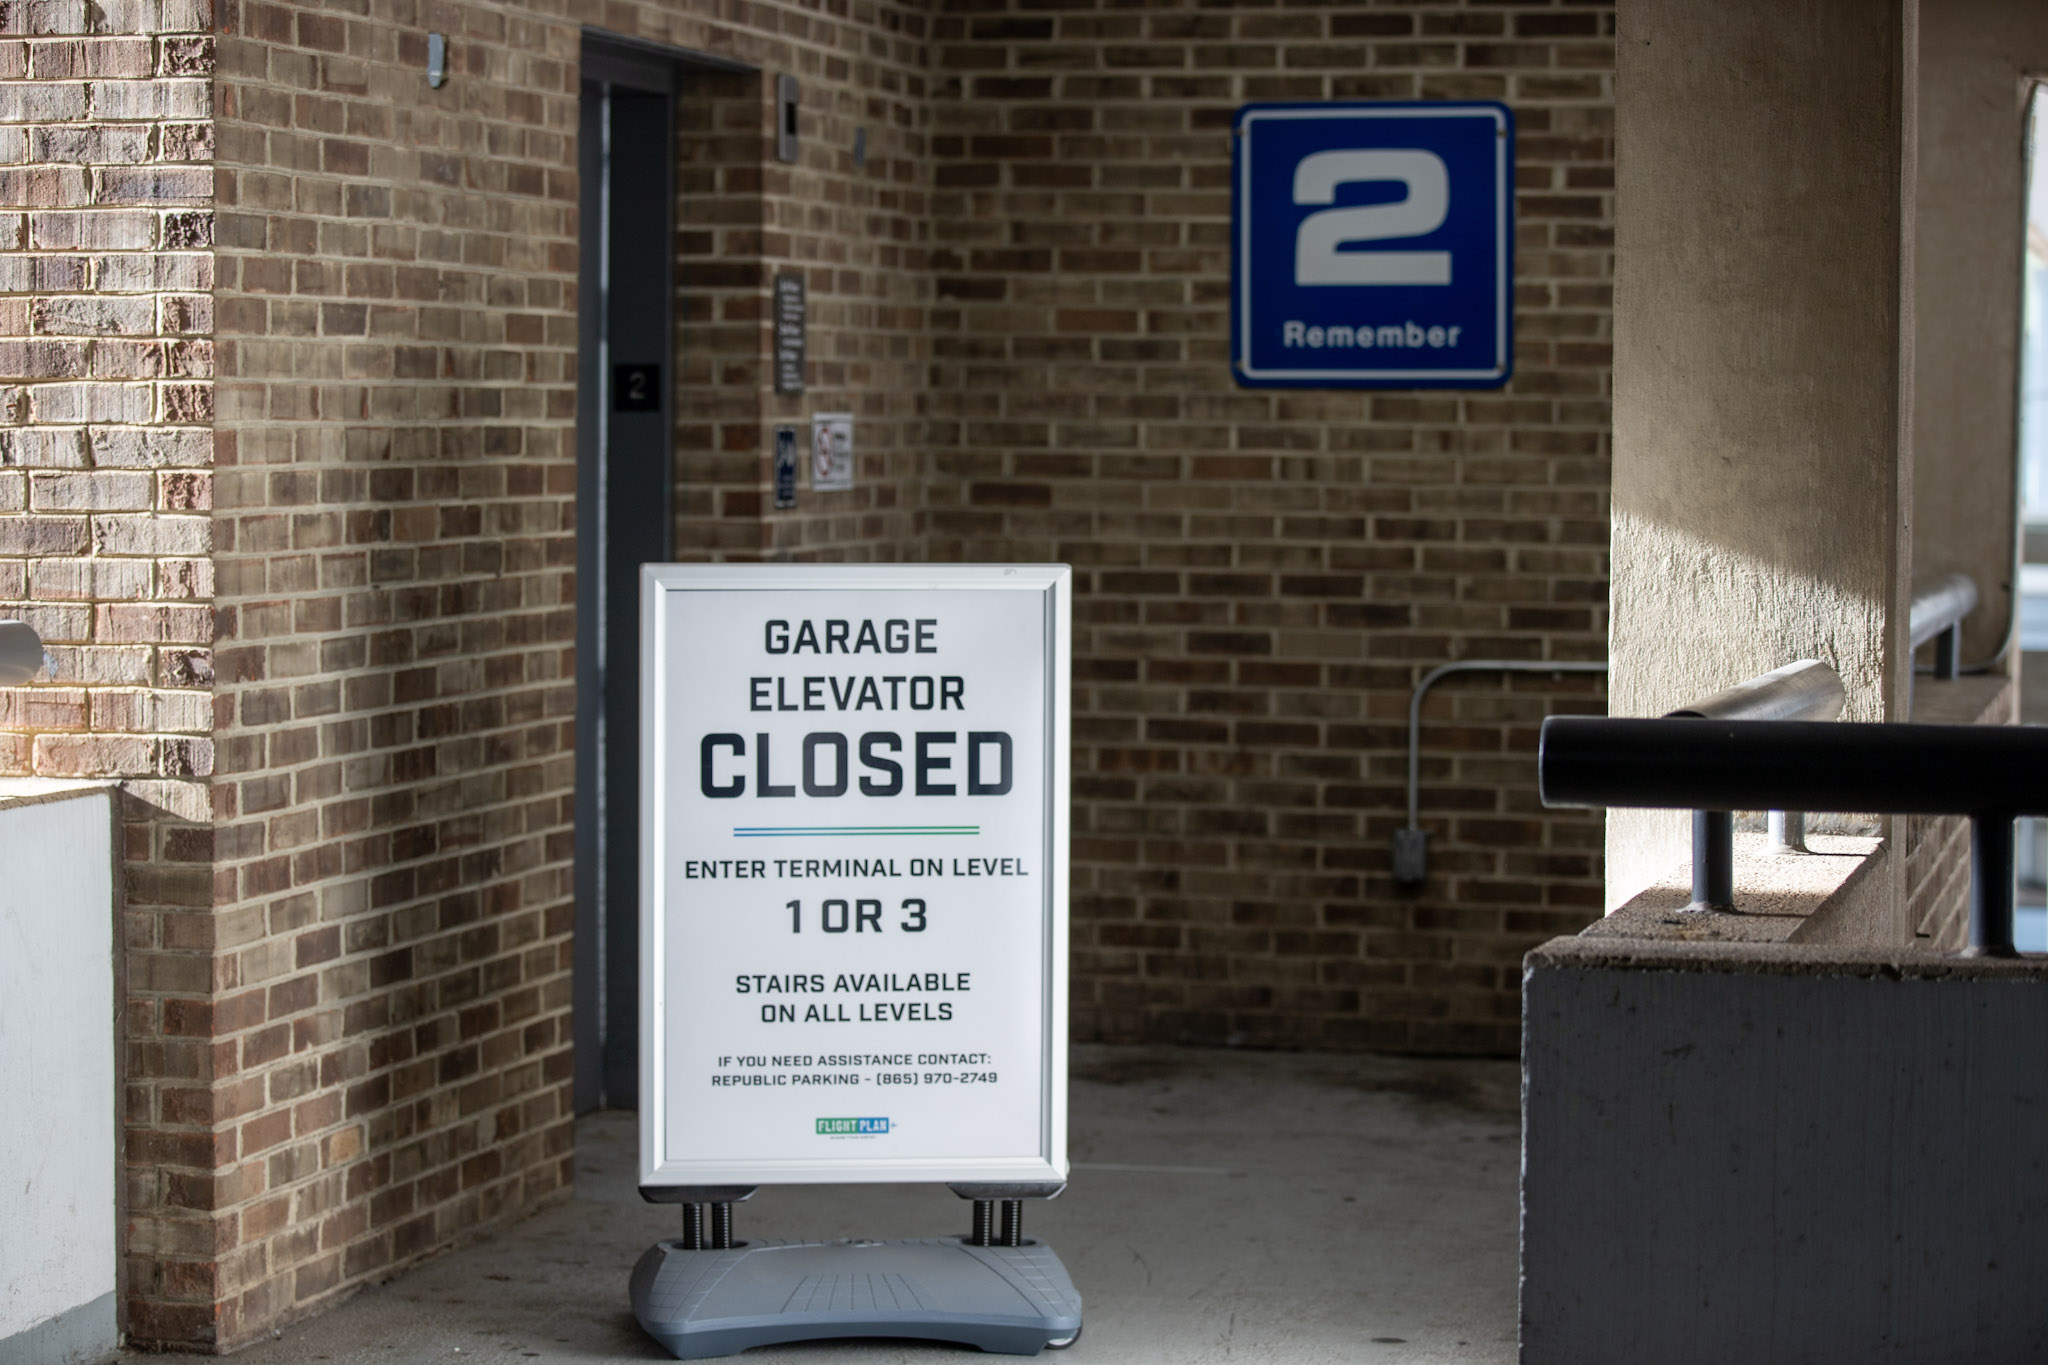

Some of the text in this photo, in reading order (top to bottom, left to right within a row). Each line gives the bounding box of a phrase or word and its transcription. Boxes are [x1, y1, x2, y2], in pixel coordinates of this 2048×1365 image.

[1292, 147, 1452, 286] 2
[1283, 319, 1461, 348] Remember
[628, 371, 647, 400] 2
[764, 618, 938, 655] GARAGE
[749, 675, 965, 712] ELEVATOR
[700, 730, 1013, 799] CLOSED
[685, 858, 1029, 879] ENTER TERMINAL ON LEVEL
[785, 898, 927, 934] 1 OR 3
[735, 972, 971, 994] STAIRS AVAILABLE
[761, 1002, 953, 1023] ON ALL LEVELS
[718, 1053, 992, 1067] IF YOU NEED ASSISTANCE CONTACT:
[711, 1074, 787, 1087] REPUBLIC
[791, 1073, 860, 1086] PARKING
[876, 1073, 919, 1086] (865)
[923, 1072, 998, 1085] 970-2749
[818, 1119, 887, 1132] FLIGHT PLAN
